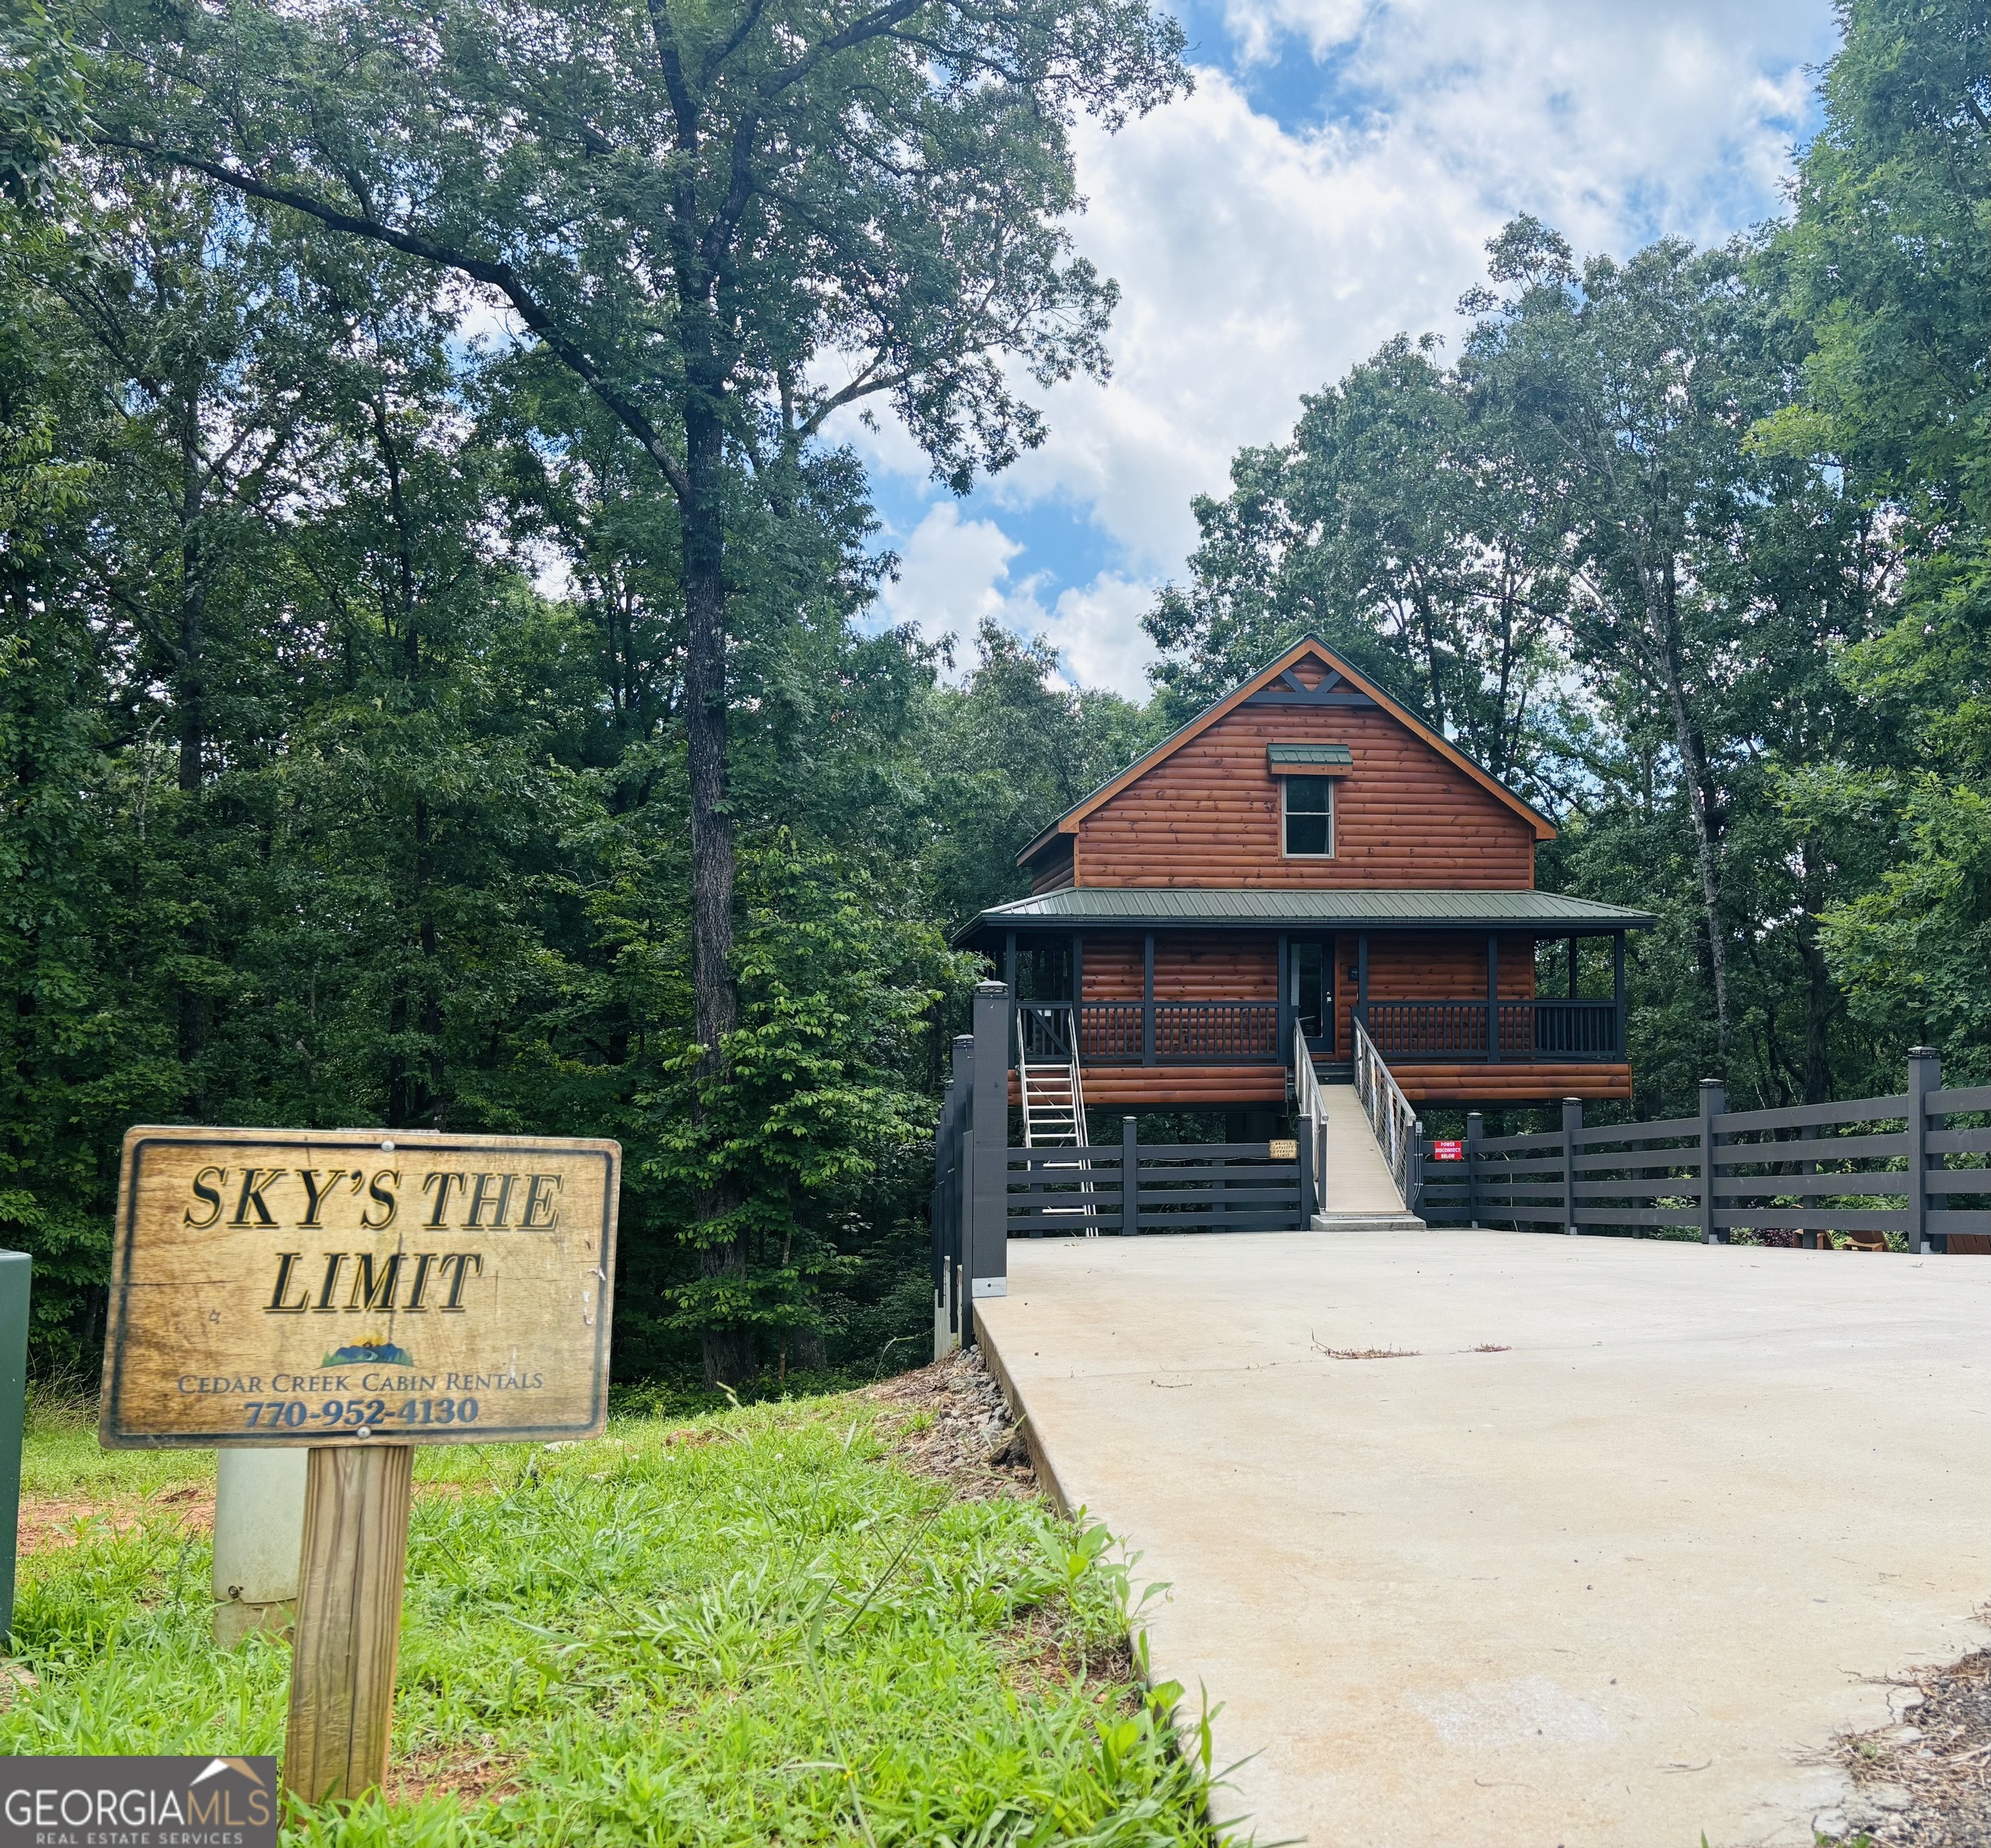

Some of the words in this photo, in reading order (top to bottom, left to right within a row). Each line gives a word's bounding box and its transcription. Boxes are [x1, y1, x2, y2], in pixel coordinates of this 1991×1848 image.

[183, 1165, 402, 1231] SKY'S
[422, 1171, 564, 1232] THE
[262, 1251, 483, 1315] LIMIT
[177, 1374, 262, 1395] CEDAR
[271, 1373, 349, 1393] CREEK
[362, 1372, 436, 1392] CABIN
[445, 1372, 544, 1391] RENTALS
[244, 1396, 480, 1428] 770-952-4130
